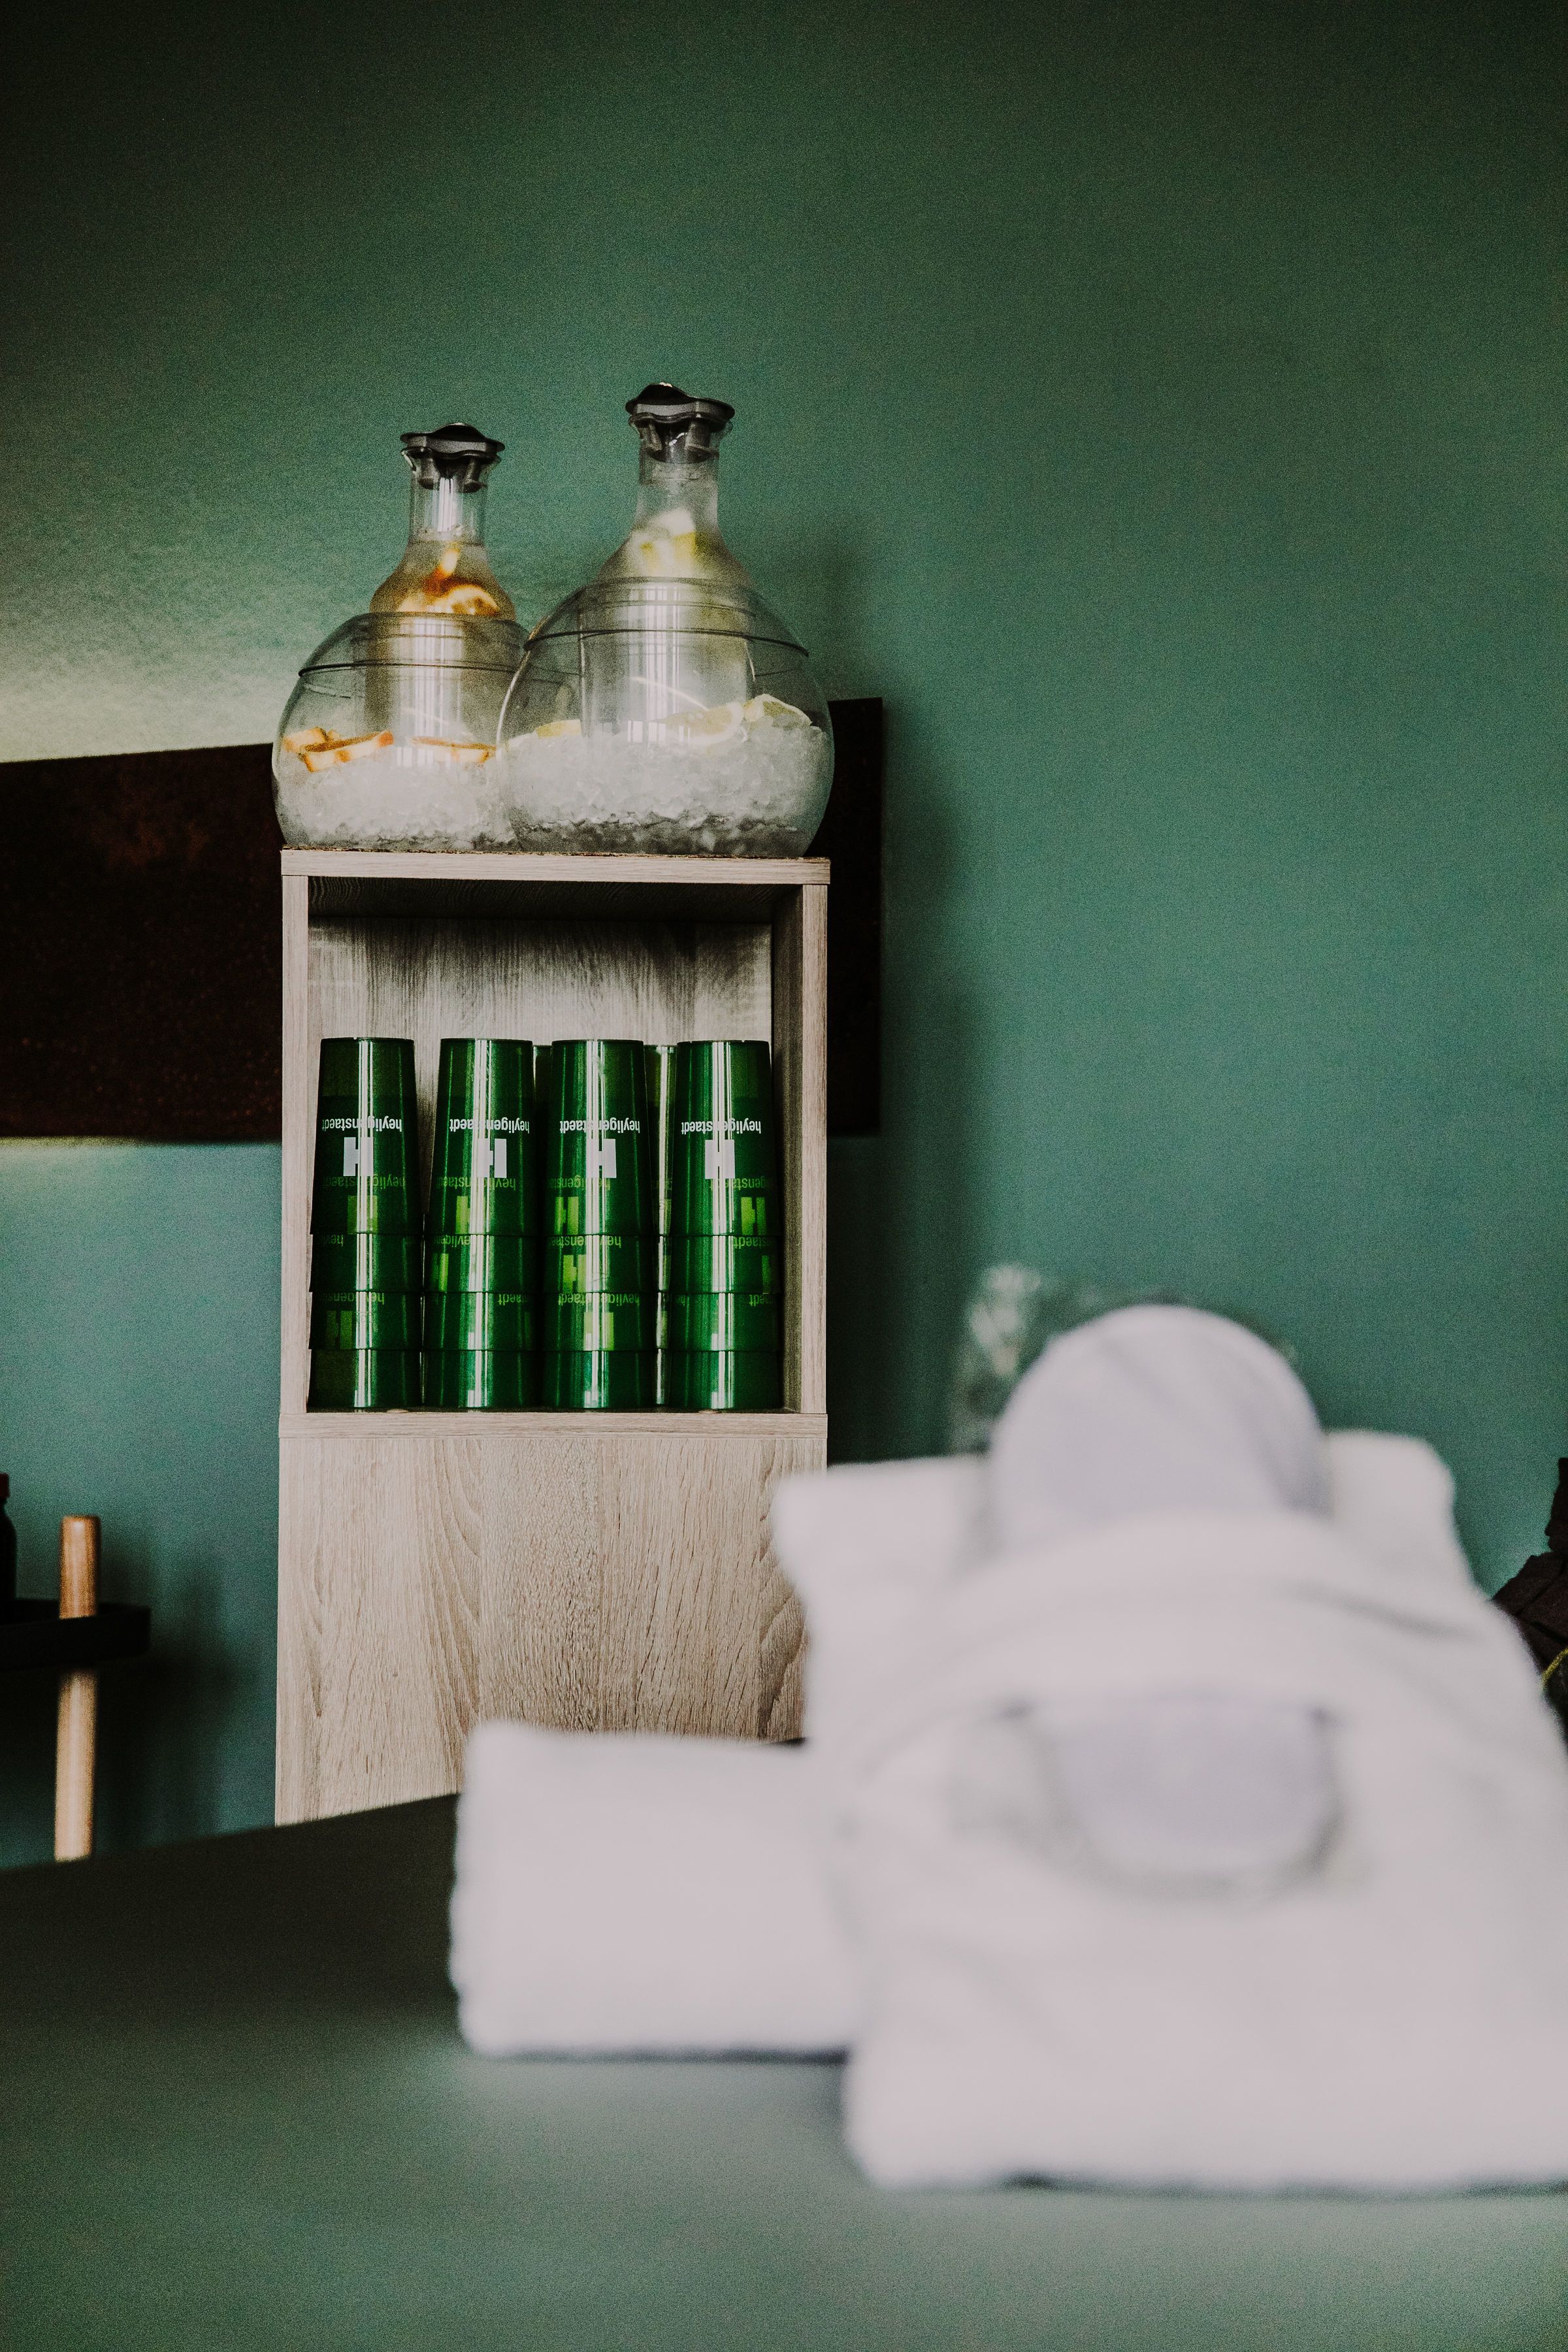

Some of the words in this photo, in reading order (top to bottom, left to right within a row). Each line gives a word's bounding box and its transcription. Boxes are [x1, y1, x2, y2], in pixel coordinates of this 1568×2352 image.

[321, 1115, 402, 1132] heylignstaedt
[449, 1117, 530, 1134] heyligenaedt
[559, 1117, 640, 1134] heyligentaedt
[681, 1118, 762, 1134] heyligestaedt
